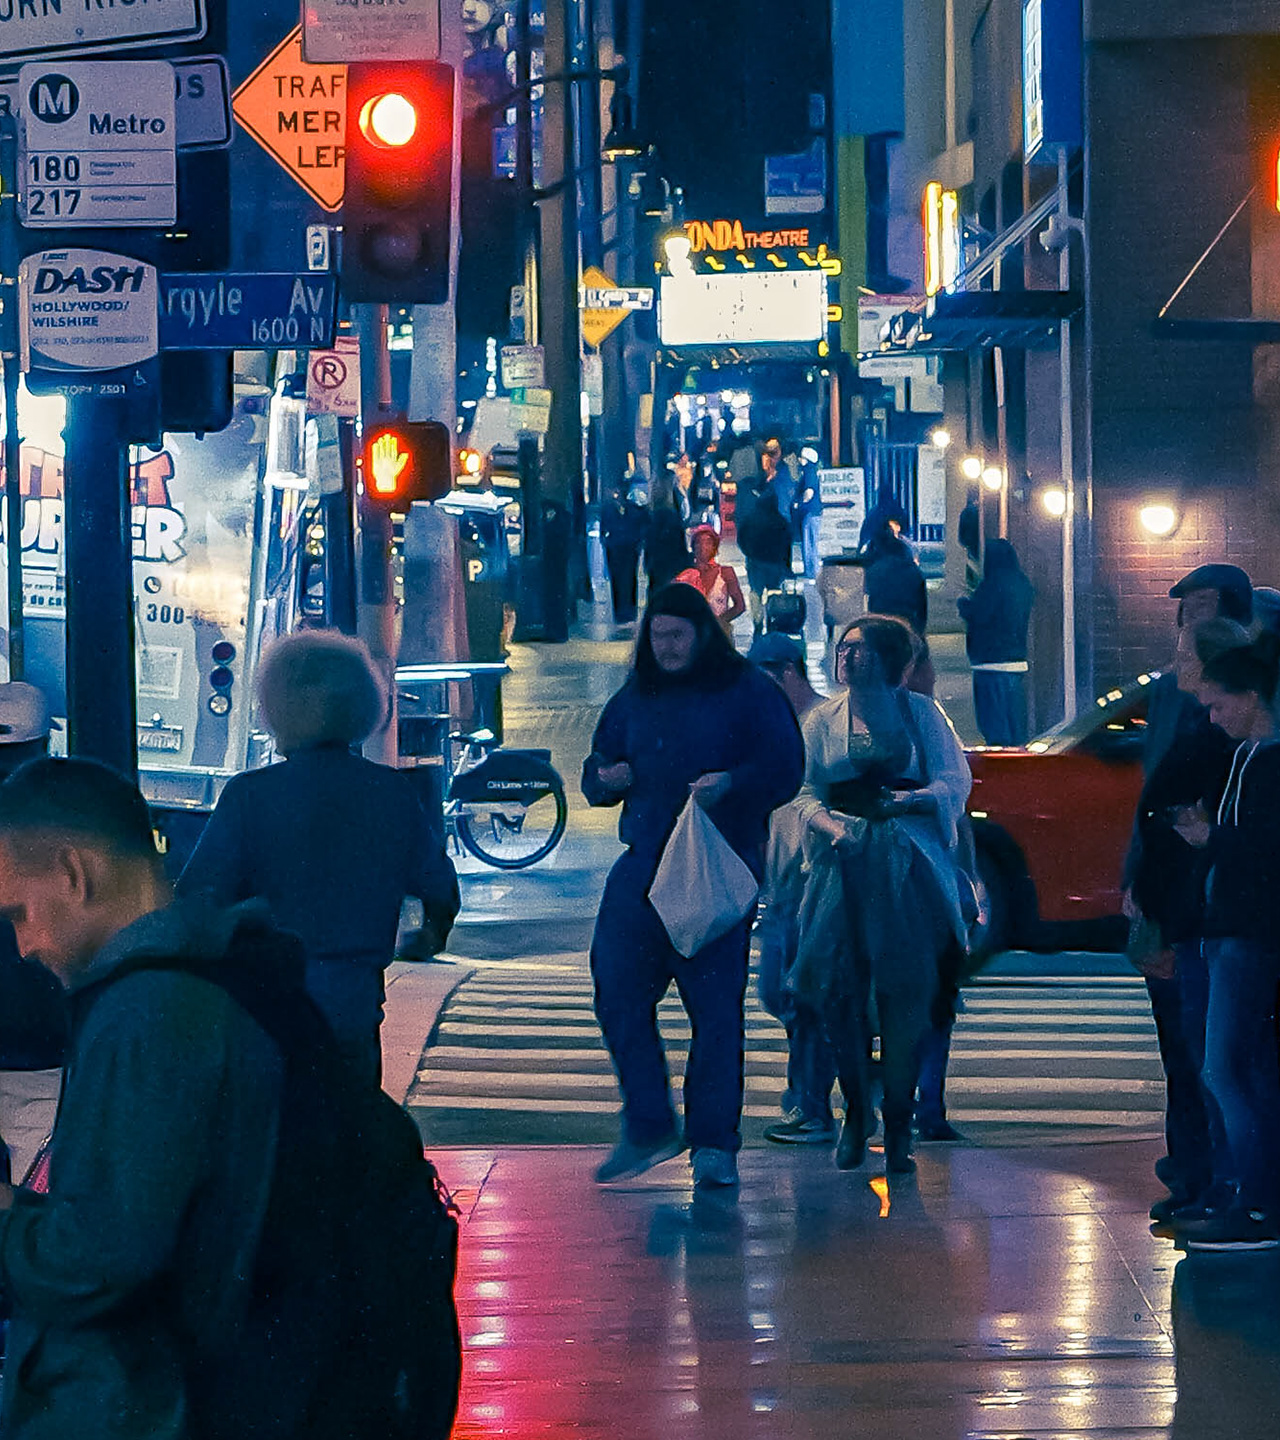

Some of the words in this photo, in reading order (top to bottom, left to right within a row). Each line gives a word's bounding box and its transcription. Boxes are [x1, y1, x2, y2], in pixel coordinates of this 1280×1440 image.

[273, 75, 345, 98] TRAF
[89, 113, 166, 135] Metro
[278, 111, 341, 134] MER
[298, 146, 346, 168] LEF
[29, 156, 80, 182] 180
[29, 190, 81, 216] 217
[744, 228, 809, 249] THEATRE
[33, 265, 145, 295] DASH
[167, 278, 243, 328] rgyle
[288, 277, 324, 315] Av
[32, 316, 99, 328] WILSHIRE
[251, 318, 300, 343] 1600
[310, 319, 324, 342] N
